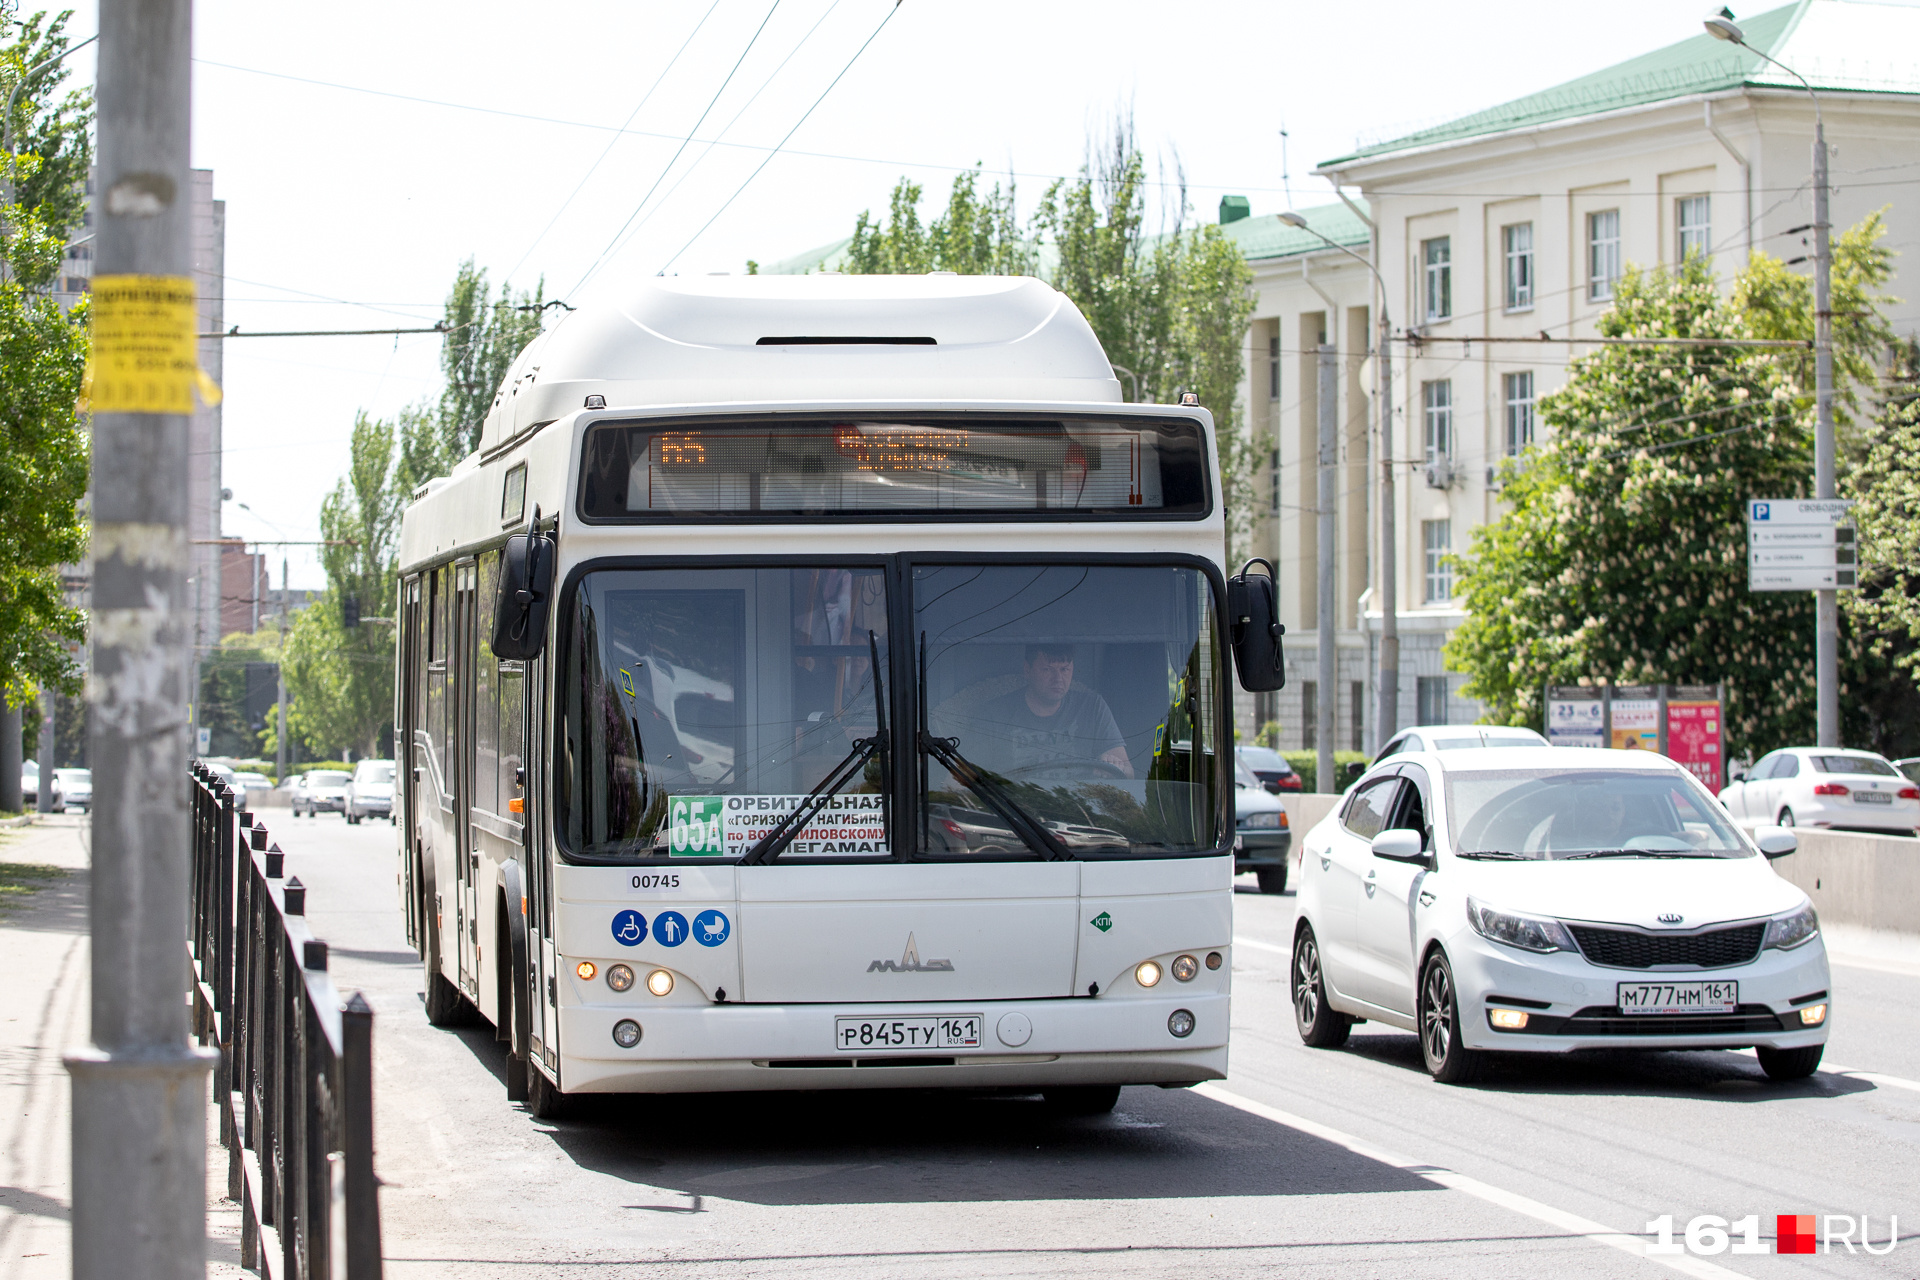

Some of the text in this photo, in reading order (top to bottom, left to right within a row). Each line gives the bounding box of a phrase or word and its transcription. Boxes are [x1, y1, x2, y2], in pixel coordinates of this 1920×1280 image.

[1798, 503, 1853, 513] СВОБОДНЫ
[727, 827, 886, 841] по ВОИЛОВСКОМУ
[631, 874, 680, 889] 00745
[1624, 984, 1732, 1006] М777НМ 161
[844, 1020, 974, 1046] Р845ТУ 161
[947, 1037, 965, 1045] RUS
